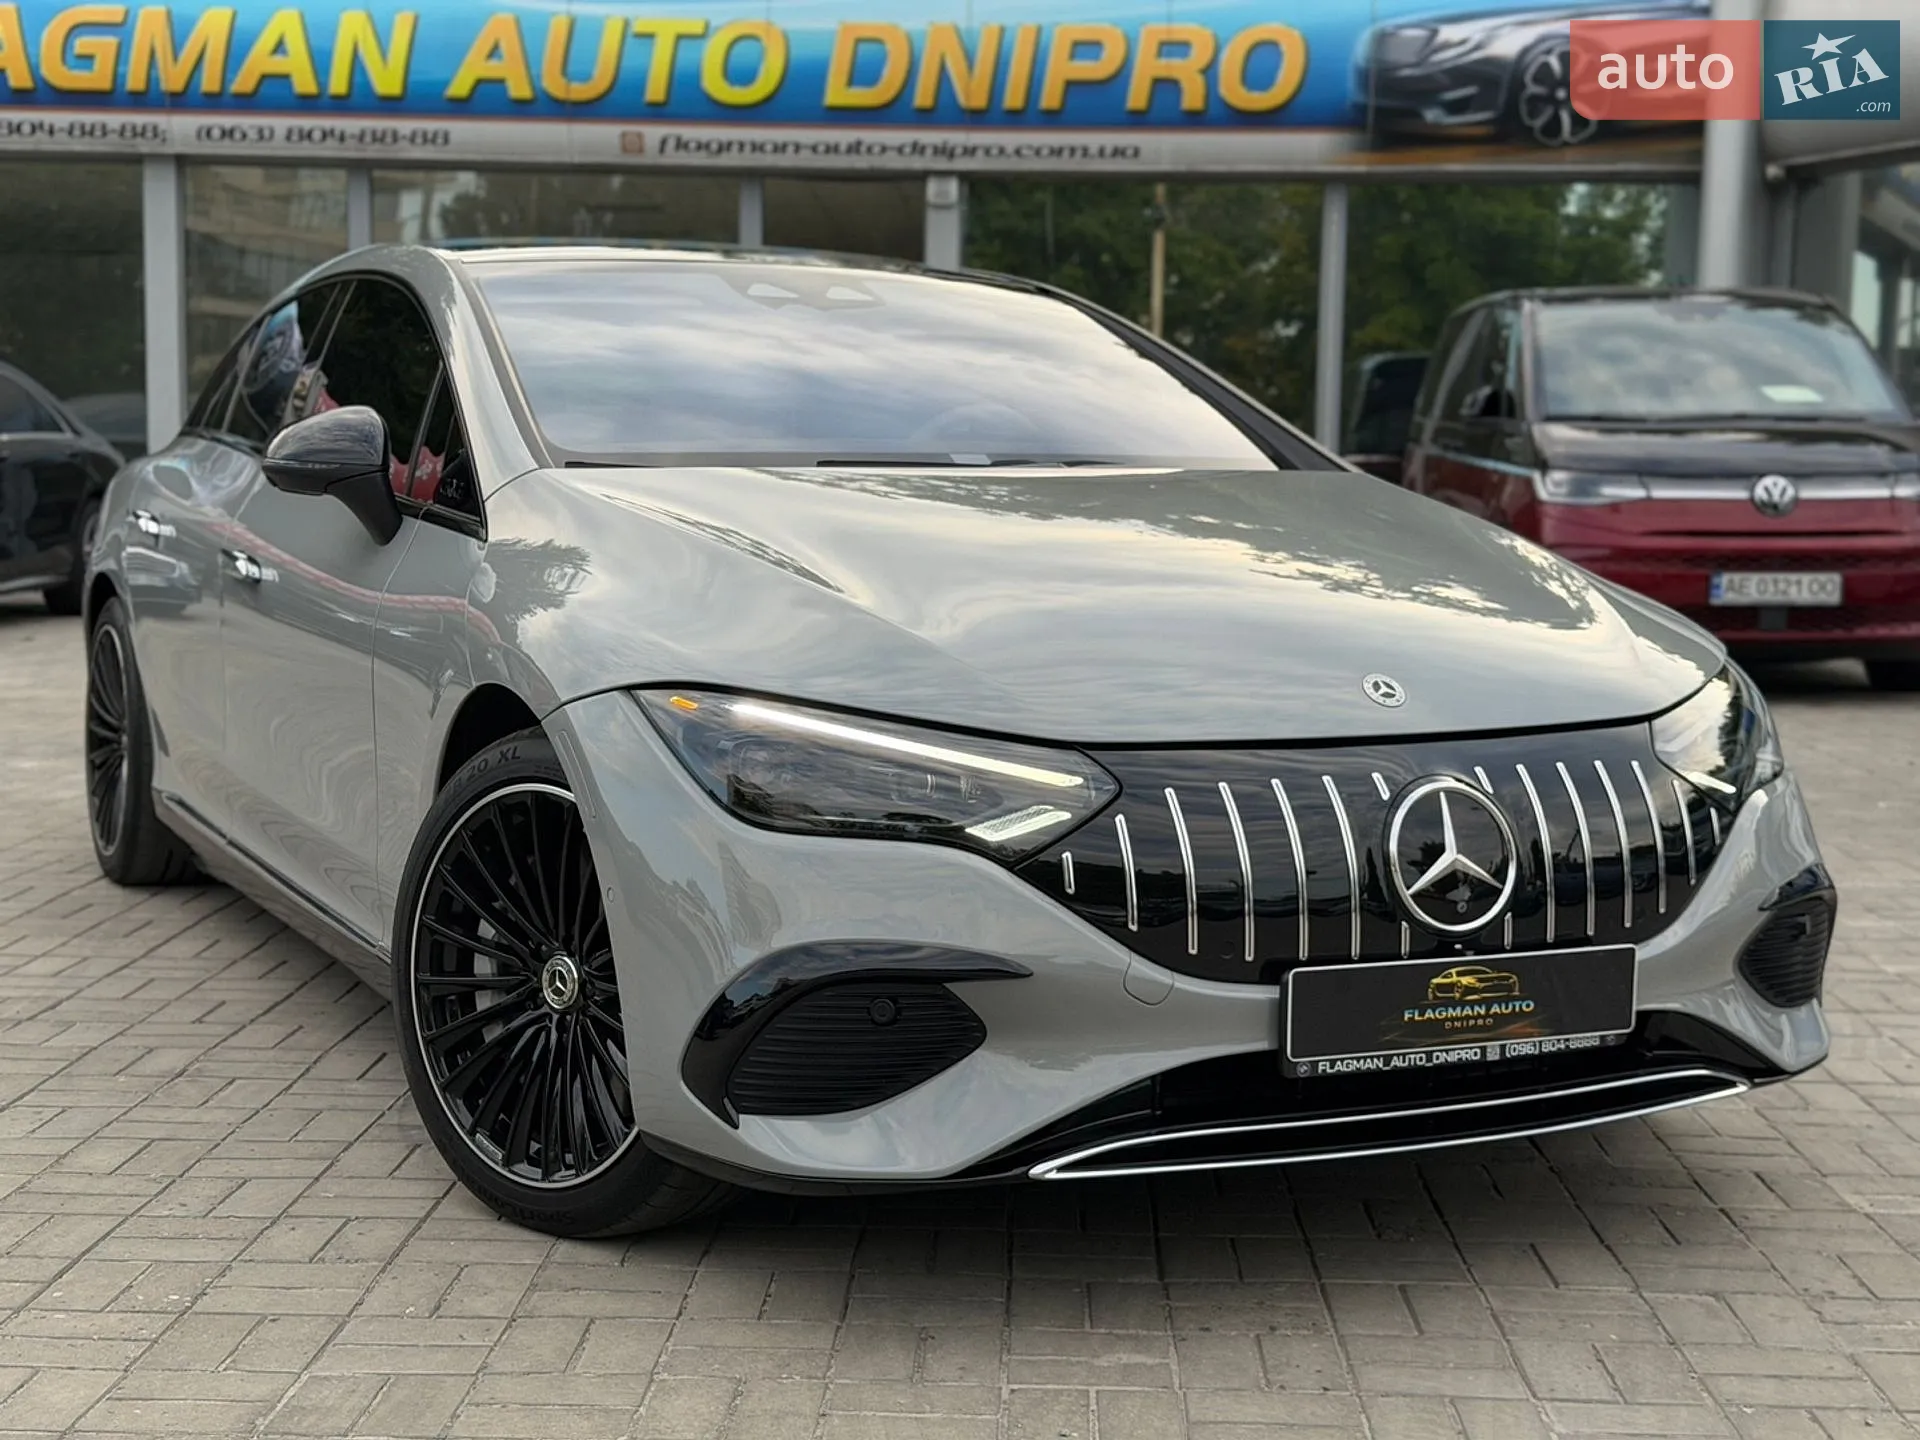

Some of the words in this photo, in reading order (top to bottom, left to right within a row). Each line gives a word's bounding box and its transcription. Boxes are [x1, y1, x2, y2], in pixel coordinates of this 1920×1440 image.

[446, 14, 788, 105] AUTO
[824, 22, 1308, 112] DNIPRO
[196, 124, 275, 144] (063)
[286, 124, 451, 147] 804-88-88
[658, 133, 1141, 162] flagman-auto-dnipro.com.ua
[497, 745, 521, 765] XL
[1403, 1003, 1486, 1022] FLAGMAN
[1489, 999, 1535, 1015] AUTO
[1444, 1017, 1494, 1030] DNIPRO
[1317, 1048, 1481, 1074] FLAGMAN_AUTO_DNIPRO
